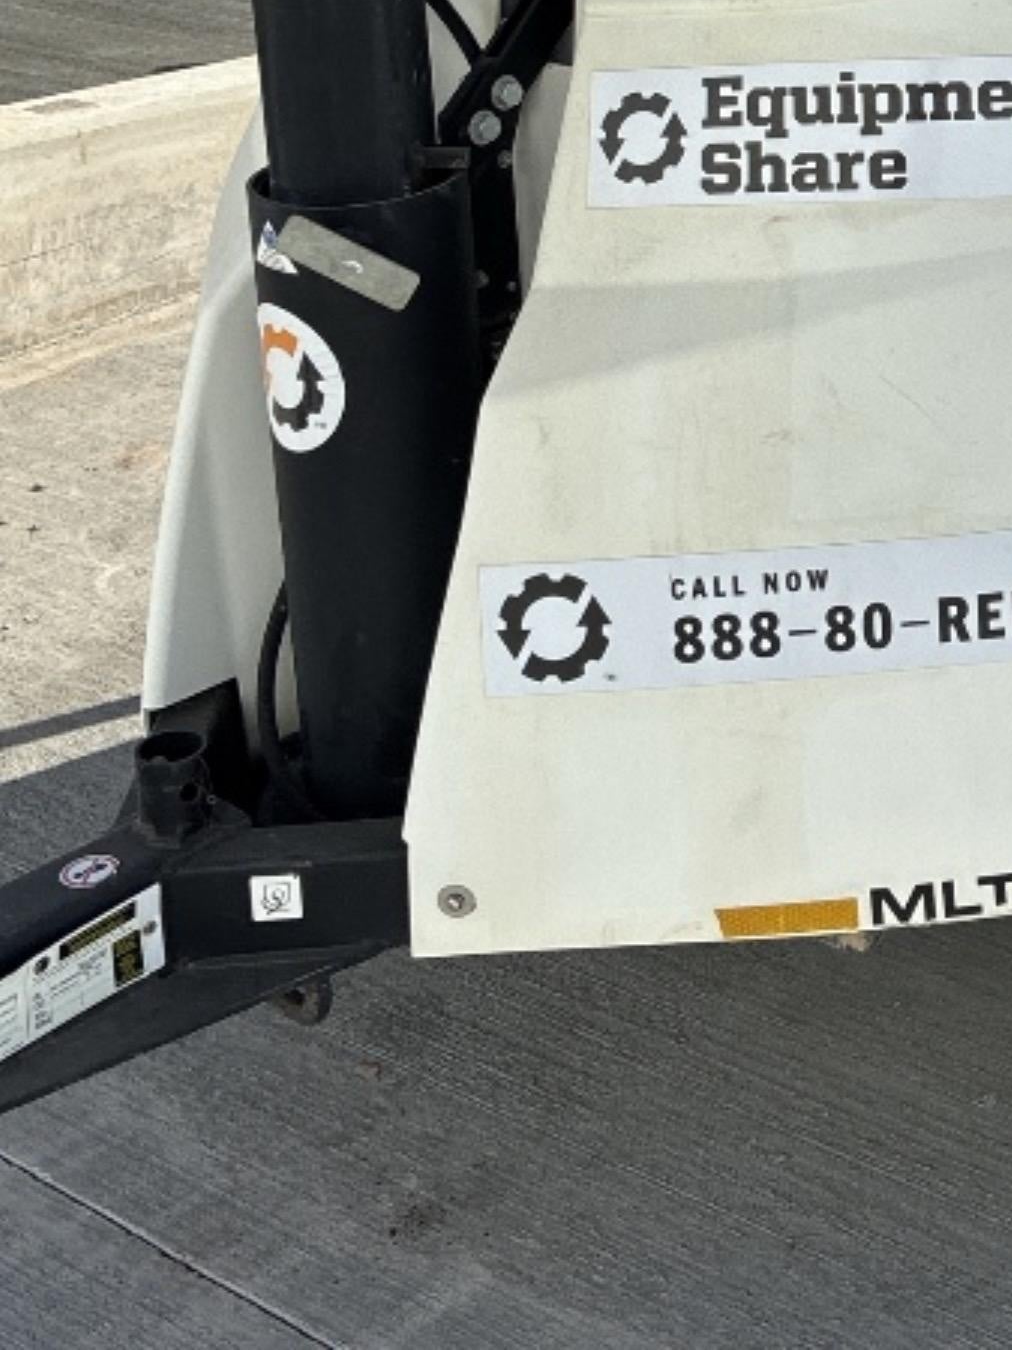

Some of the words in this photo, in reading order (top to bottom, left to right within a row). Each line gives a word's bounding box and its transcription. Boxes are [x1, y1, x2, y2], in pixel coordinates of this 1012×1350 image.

[701, 141, 908, 195] Share
[670, 572, 746, 600] CALL
[762, 569, 830, 595] NOW
